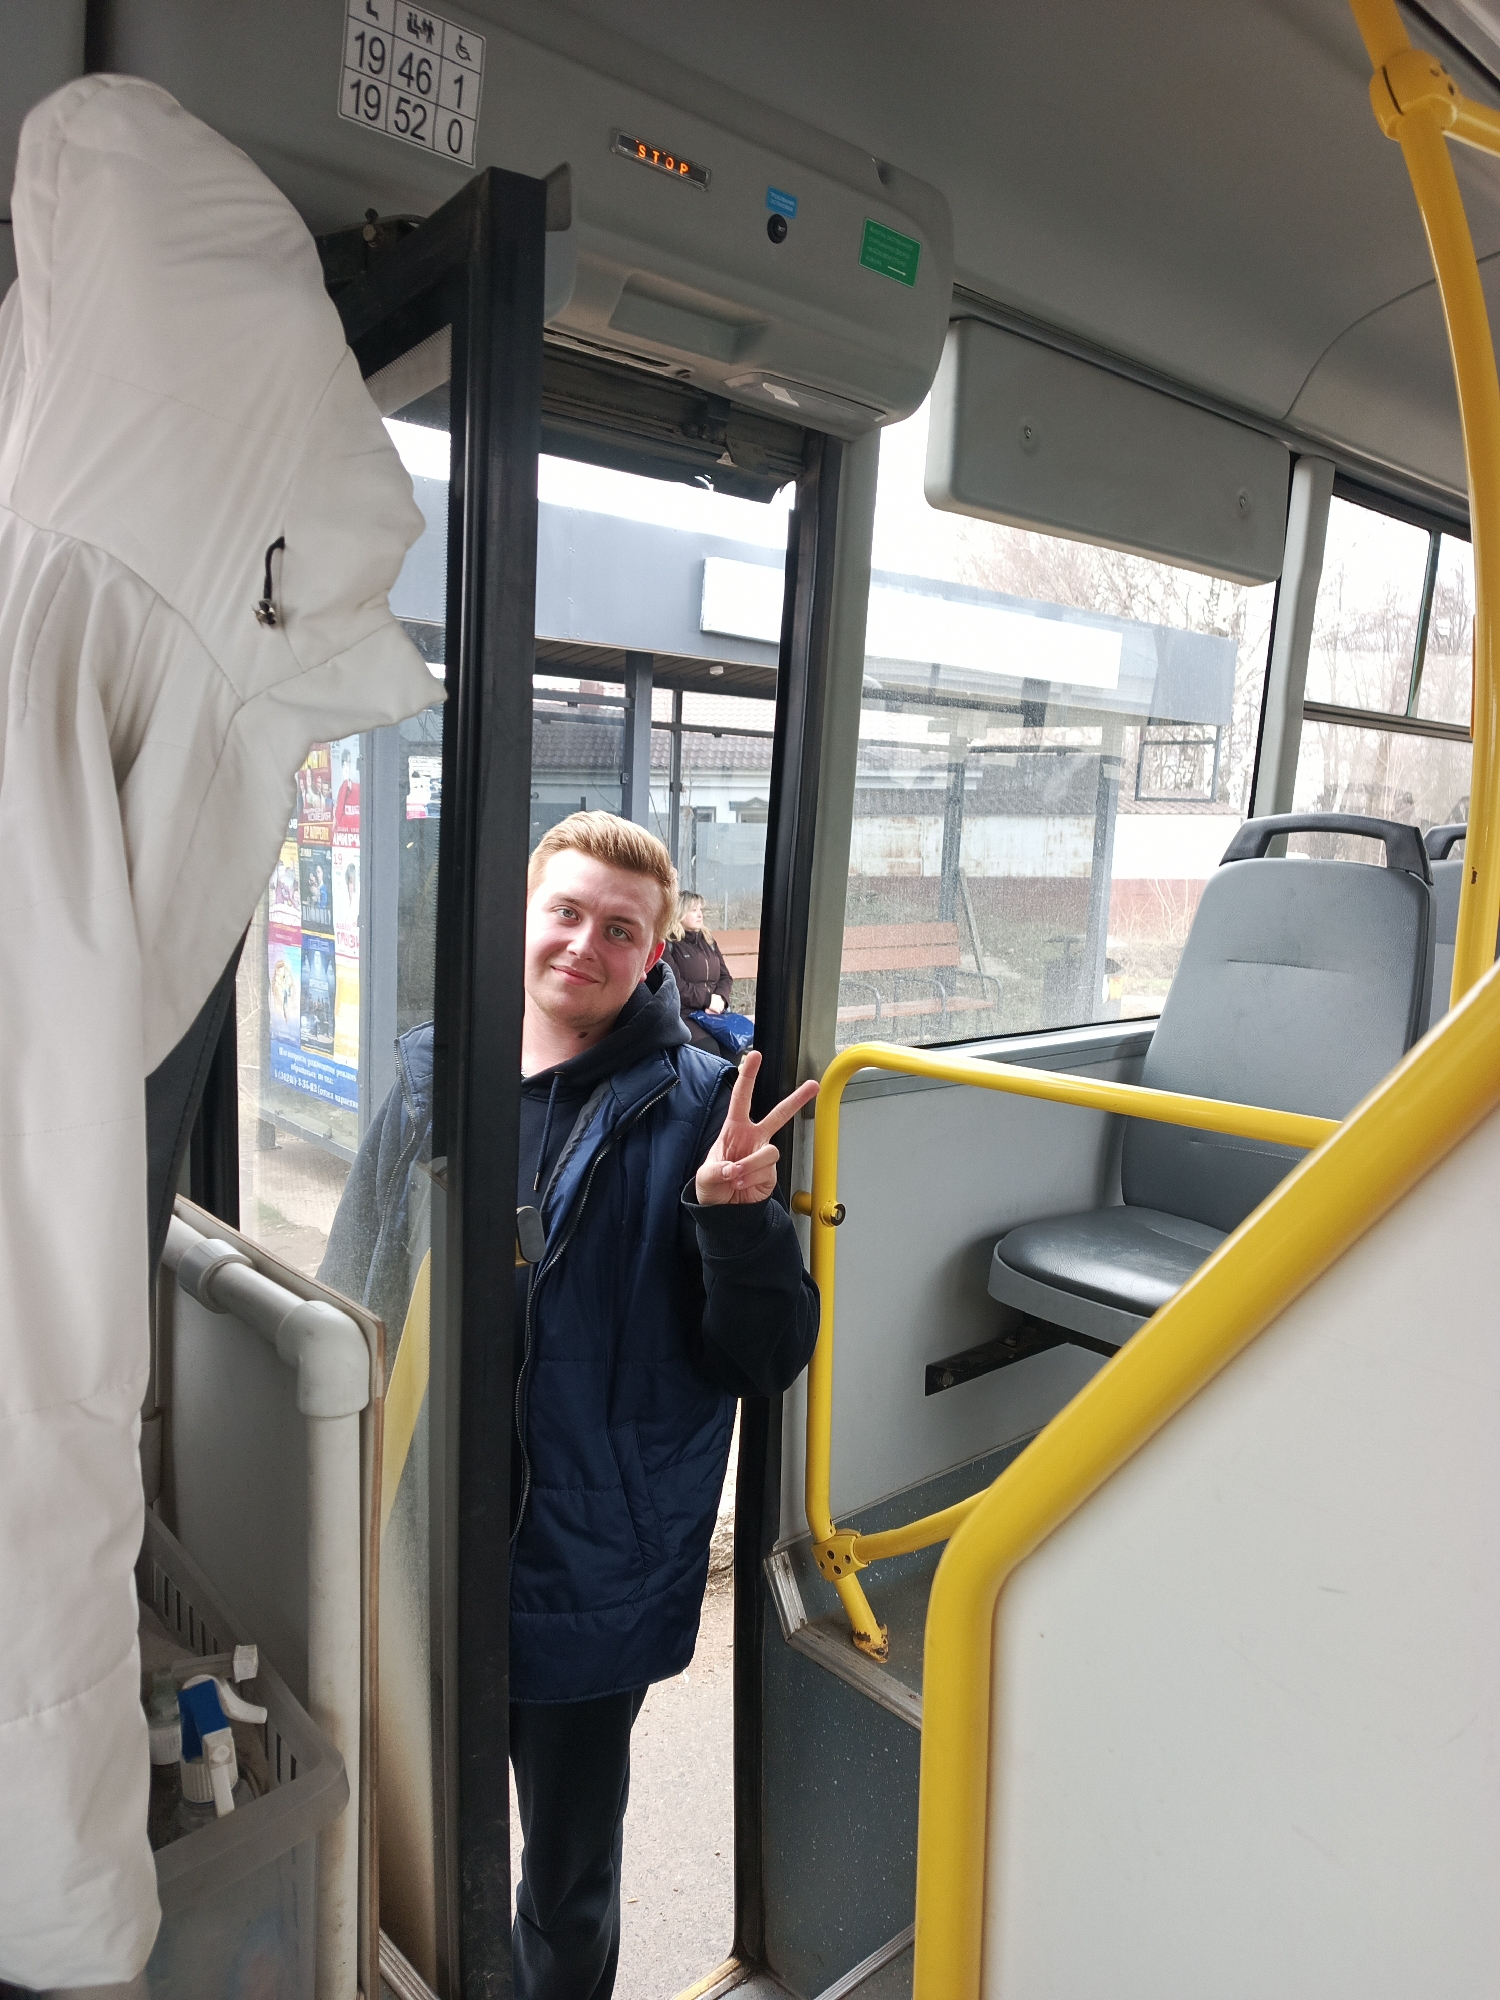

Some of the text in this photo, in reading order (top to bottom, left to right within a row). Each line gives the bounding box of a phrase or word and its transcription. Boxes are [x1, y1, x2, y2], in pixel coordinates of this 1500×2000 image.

[354, 30, 464, 110] 19 46 1
[350, 78, 464, 154] 19 52 0
[637, 143, 690, 176] STOP
